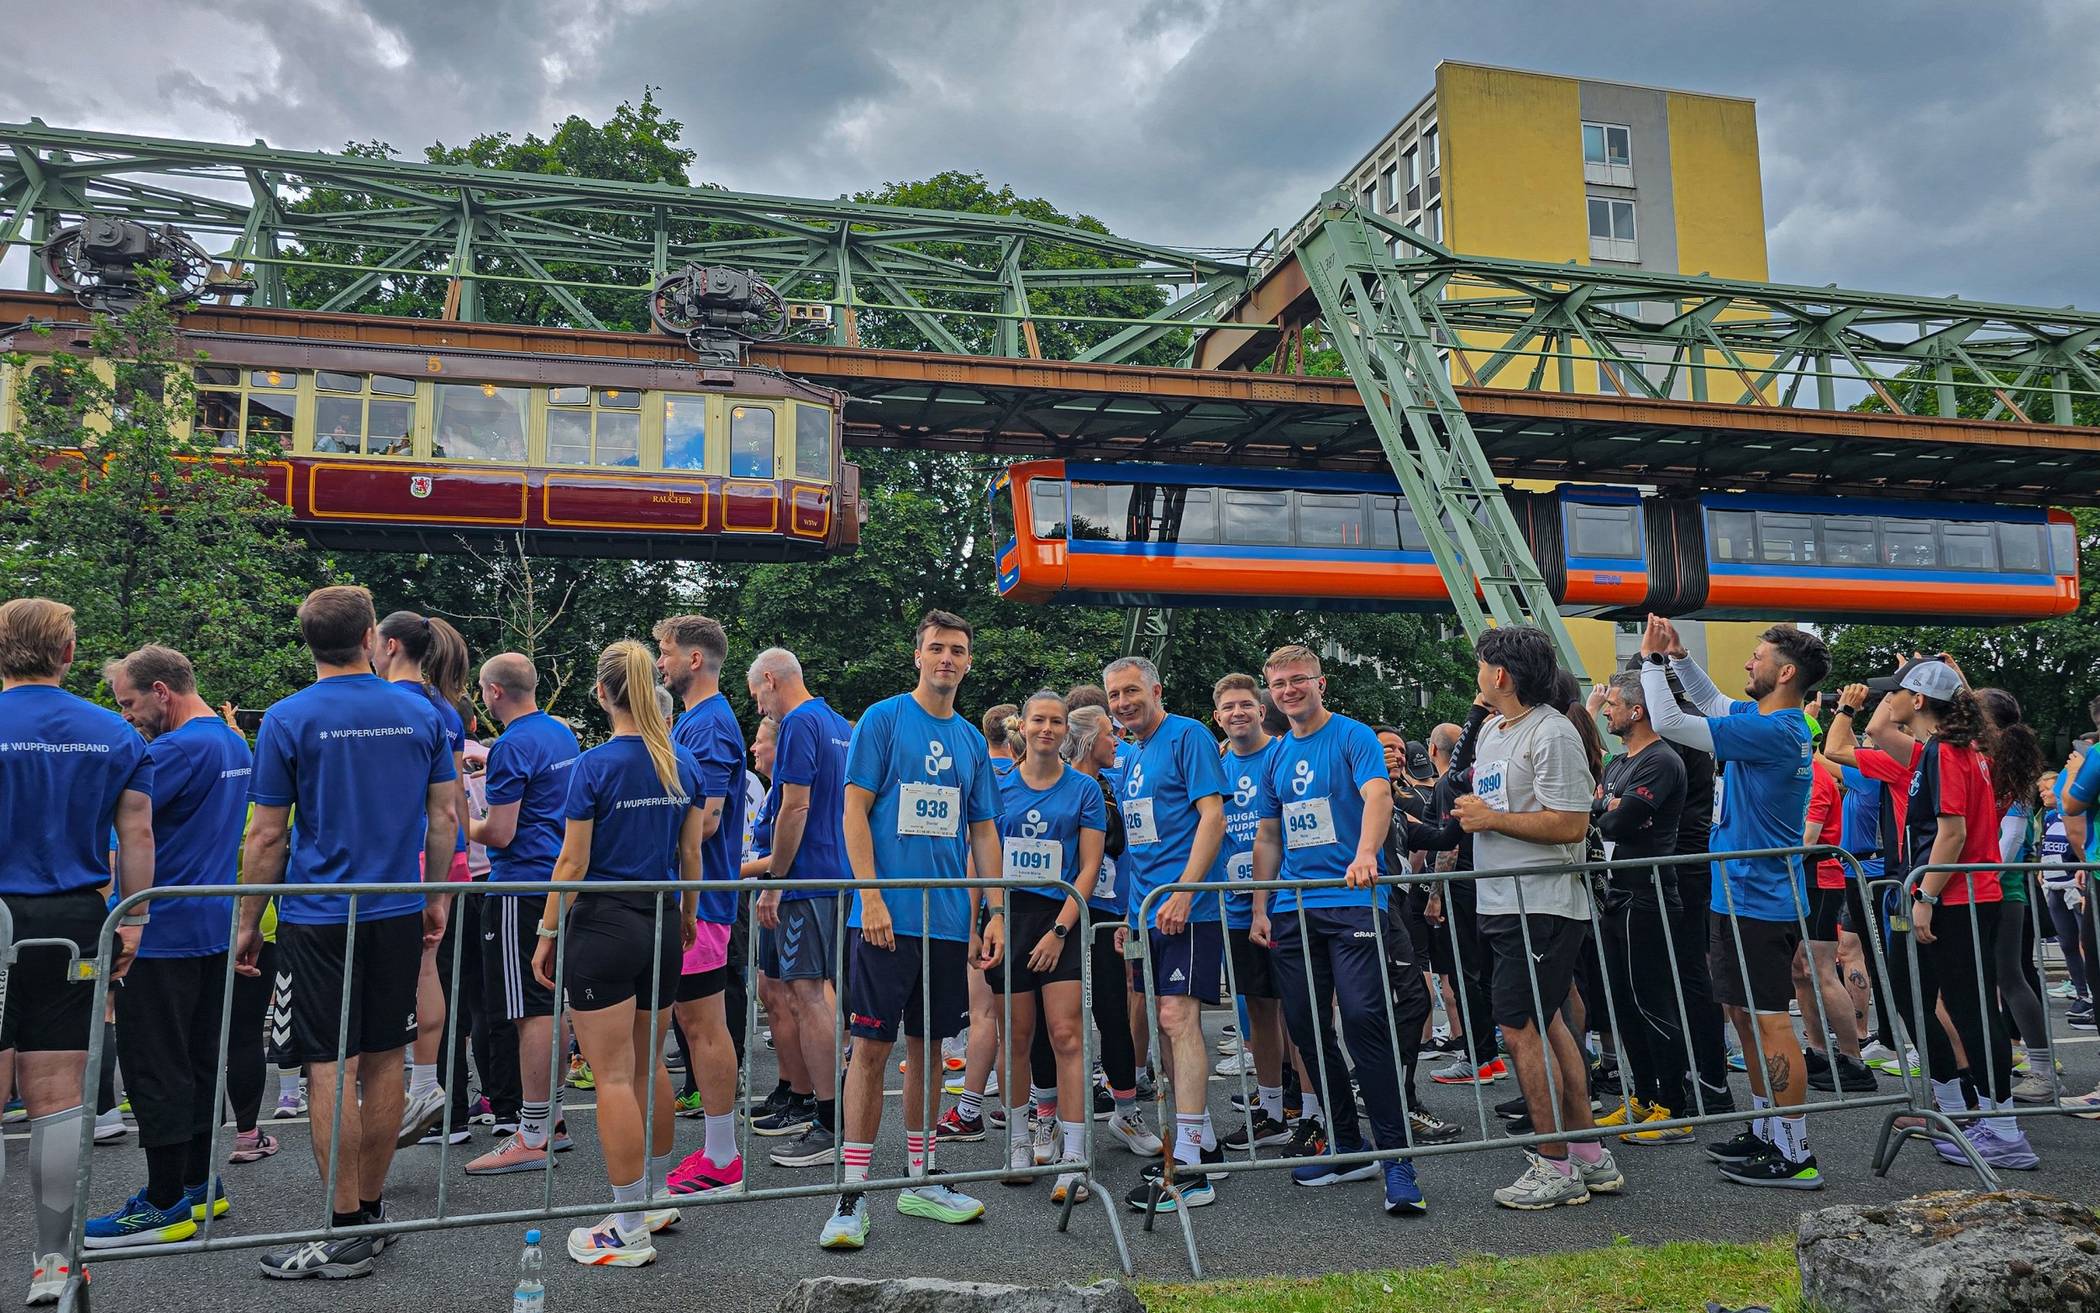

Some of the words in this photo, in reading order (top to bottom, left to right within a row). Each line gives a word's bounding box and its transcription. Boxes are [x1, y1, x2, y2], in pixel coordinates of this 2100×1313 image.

[427, 355, 443, 372] 5
[320, 730, 328, 740] #
[330, 726, 414, 738] WUPPERVERBAND
[11, 742, 110, 753] WUPPERVERBAND
[1478, 772, 1501, 796] 2890
[916, 798, 948, 819] 938
[1290, 813, 1318, 832] 943
[1237, 832, 1257, 842] TAL
[1011, 850, 1051, 869] 1091
